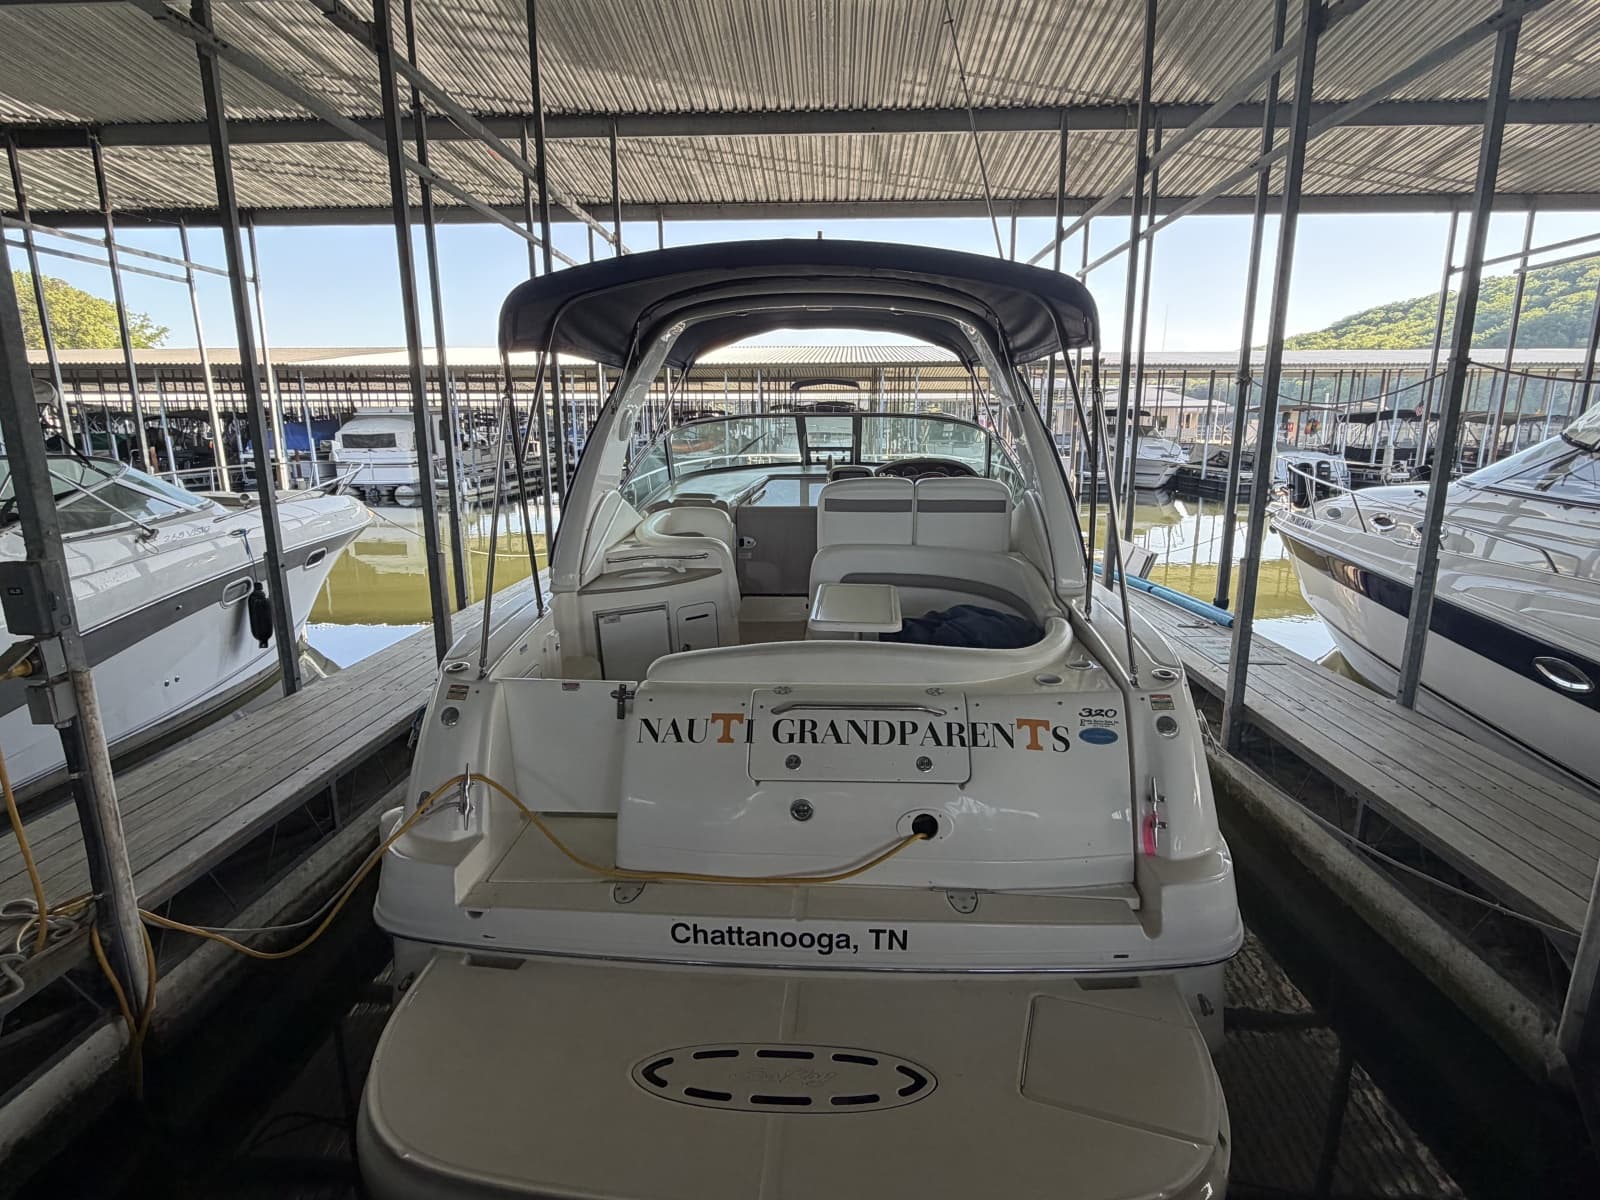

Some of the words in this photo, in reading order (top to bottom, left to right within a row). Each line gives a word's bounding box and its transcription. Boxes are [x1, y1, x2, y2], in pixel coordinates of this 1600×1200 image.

[1078, 707, 1118, 719] 320
[637, 713, 757, 744] NAUTI
[772, 718, 1071, 753] GRANDPARENTS
[670, 922, 859, 955] Chattanooga,
[868, 928, 909, 951] TN
